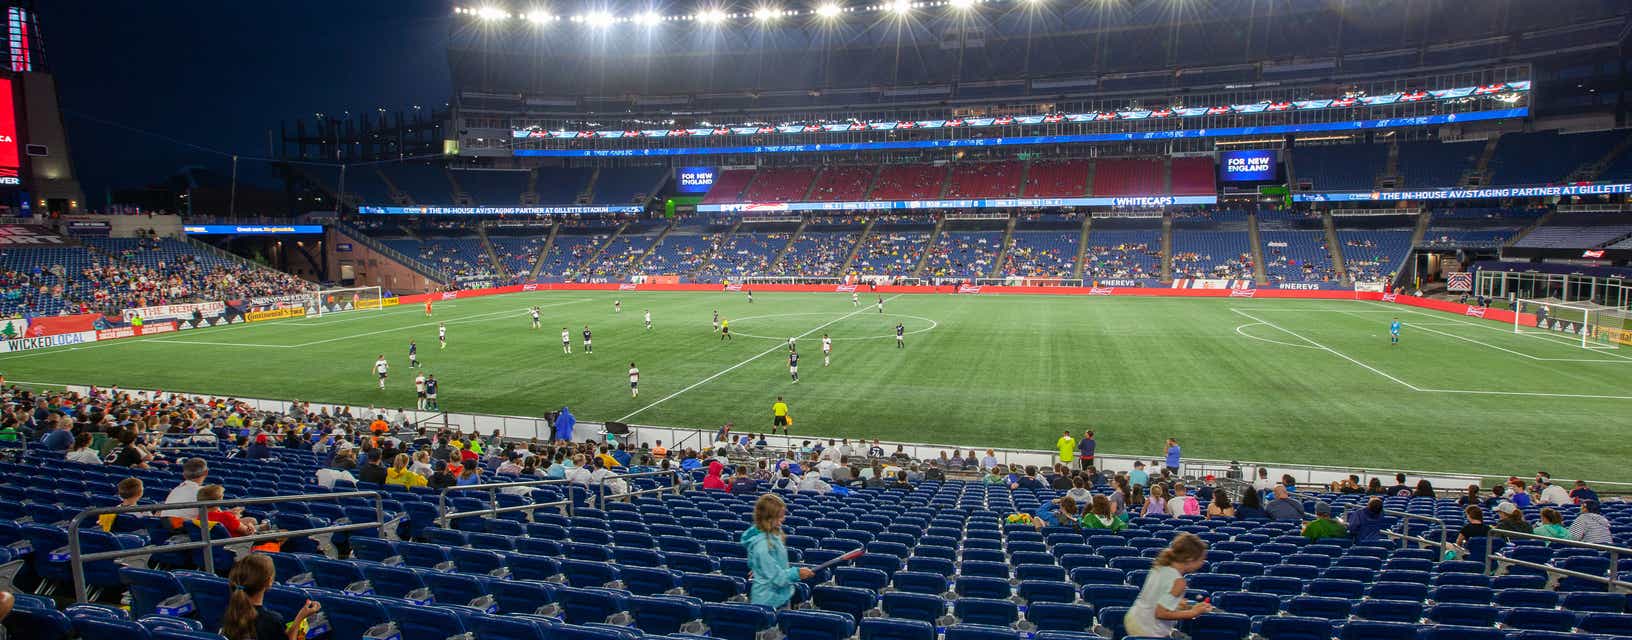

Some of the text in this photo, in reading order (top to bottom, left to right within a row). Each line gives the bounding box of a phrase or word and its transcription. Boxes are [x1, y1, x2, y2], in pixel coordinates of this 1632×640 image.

[1228, 157, 1269, 166] FOR NEW
[1382, 192, 1400, 200] THE
[1402, 191, 1447, 200] IN-HOUSE
[1449, 188, 1509, 199] AV/STAGING
[1511, 186, 1560, 197] PARTNER
[1562, 185, 1577, 195] AT
[1579, 183, 1632, 194] GILLETTE
[1115, 196, 1173, 206] WHITECAPS
[443, 207, 474, 215] IN-HOUSE
[545, 206, 554, 214] AT
[1101, 279, 1135, 287] #NEREVS
[1279, 283, 1319, 291] #NEREVS
[142, 306, 164, 316] THE
[8, 331, 85, 351] WICKEDLOCAL
